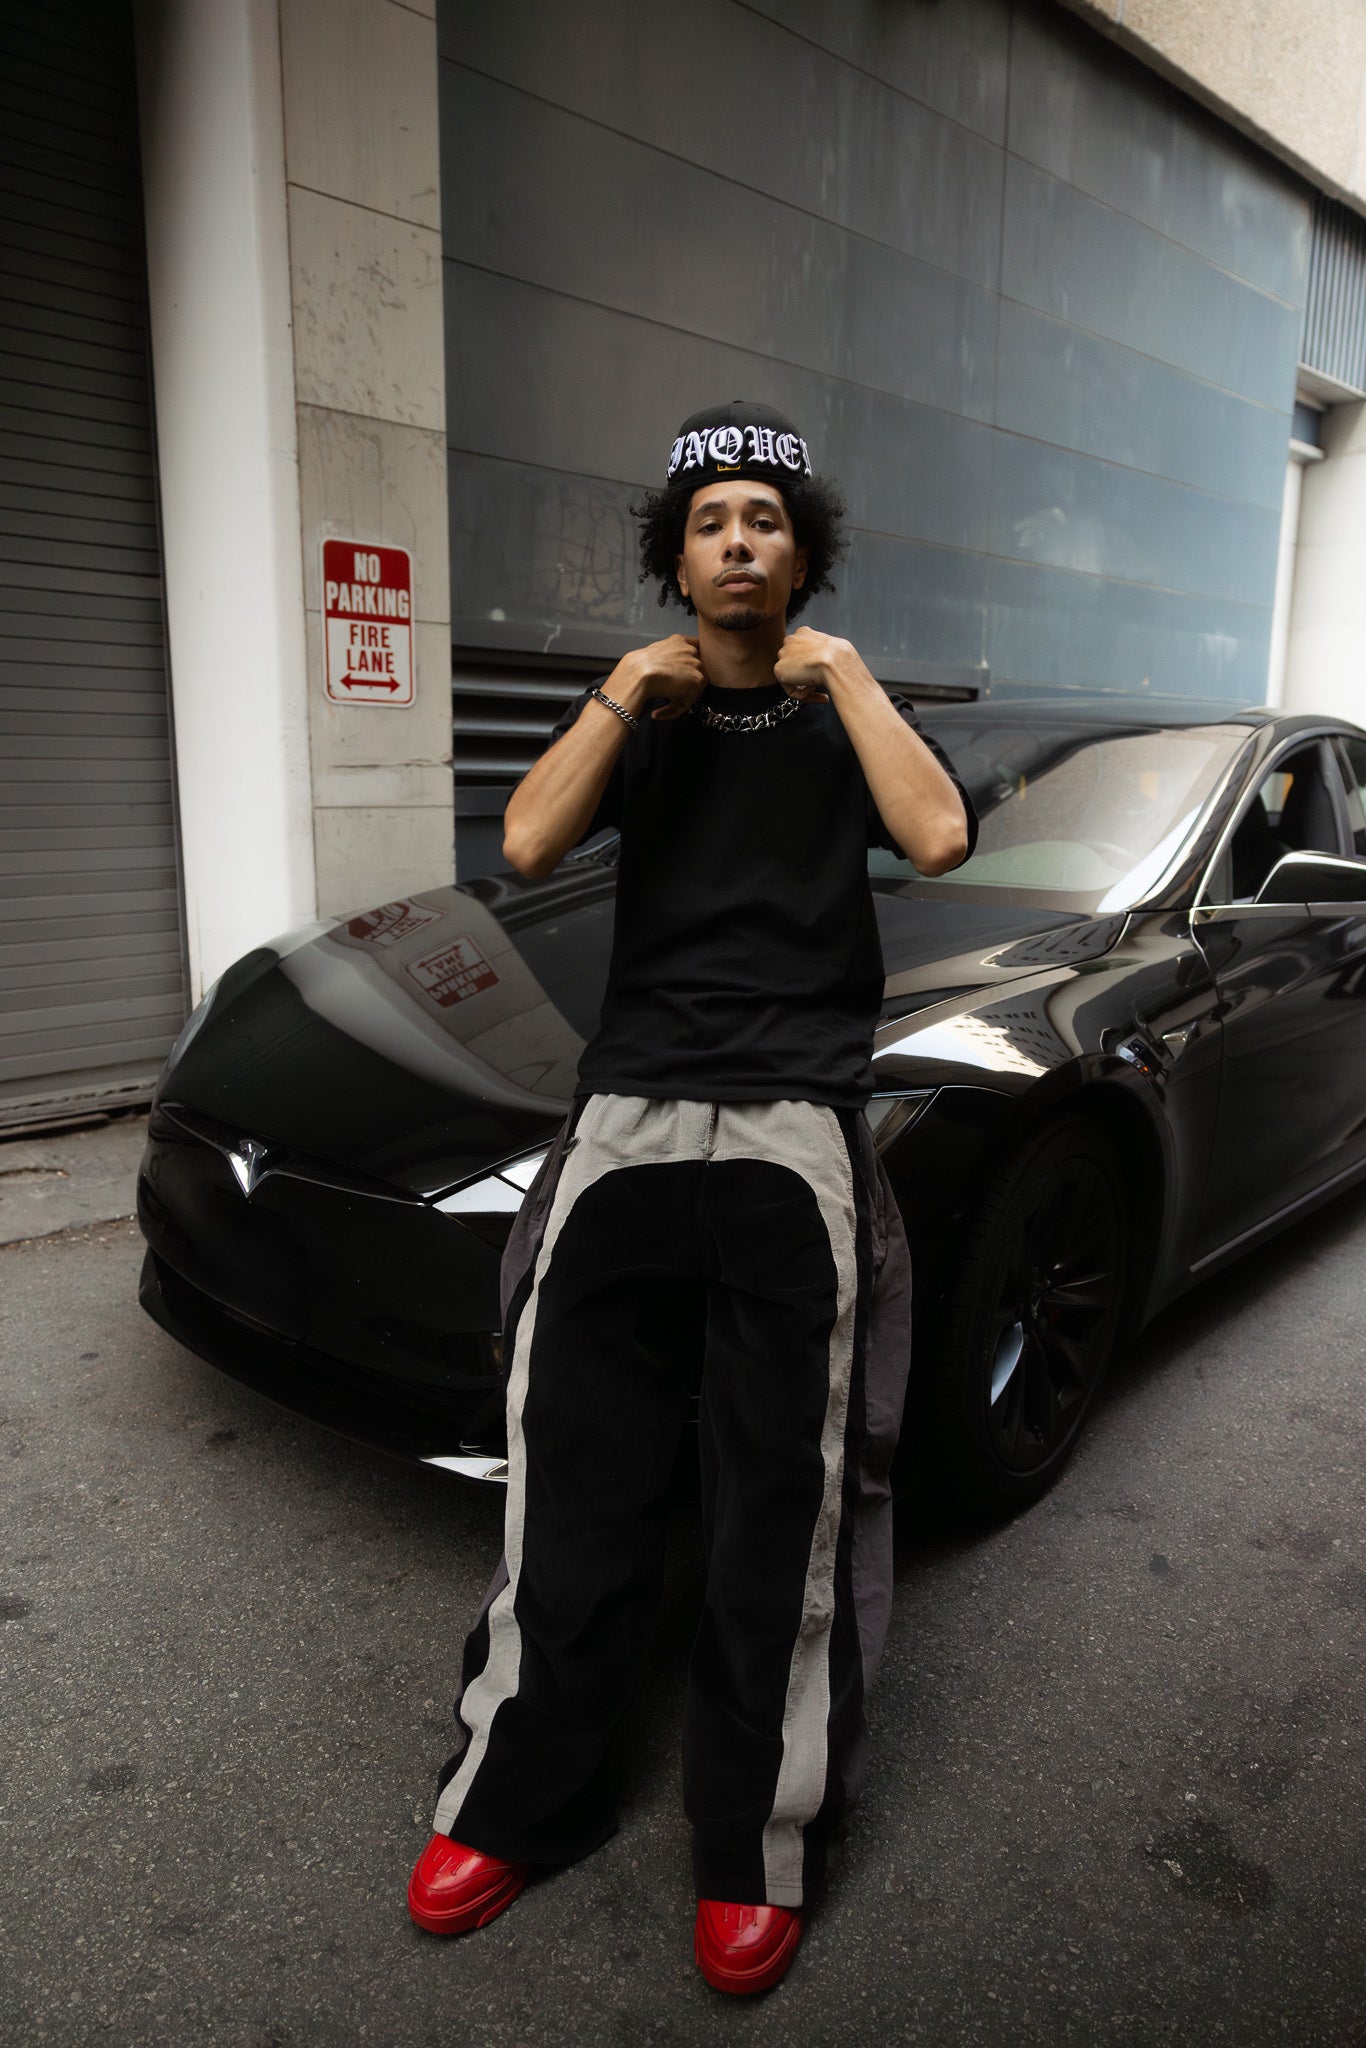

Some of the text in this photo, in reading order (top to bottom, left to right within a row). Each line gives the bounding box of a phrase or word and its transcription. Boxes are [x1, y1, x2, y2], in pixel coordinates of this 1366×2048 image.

[354, 552, 381, 583] NO
[325, 581, 410, 619] PARKING
[349, 623, 391, 649] FIRE
[346, 648, 395, 674] LANE
